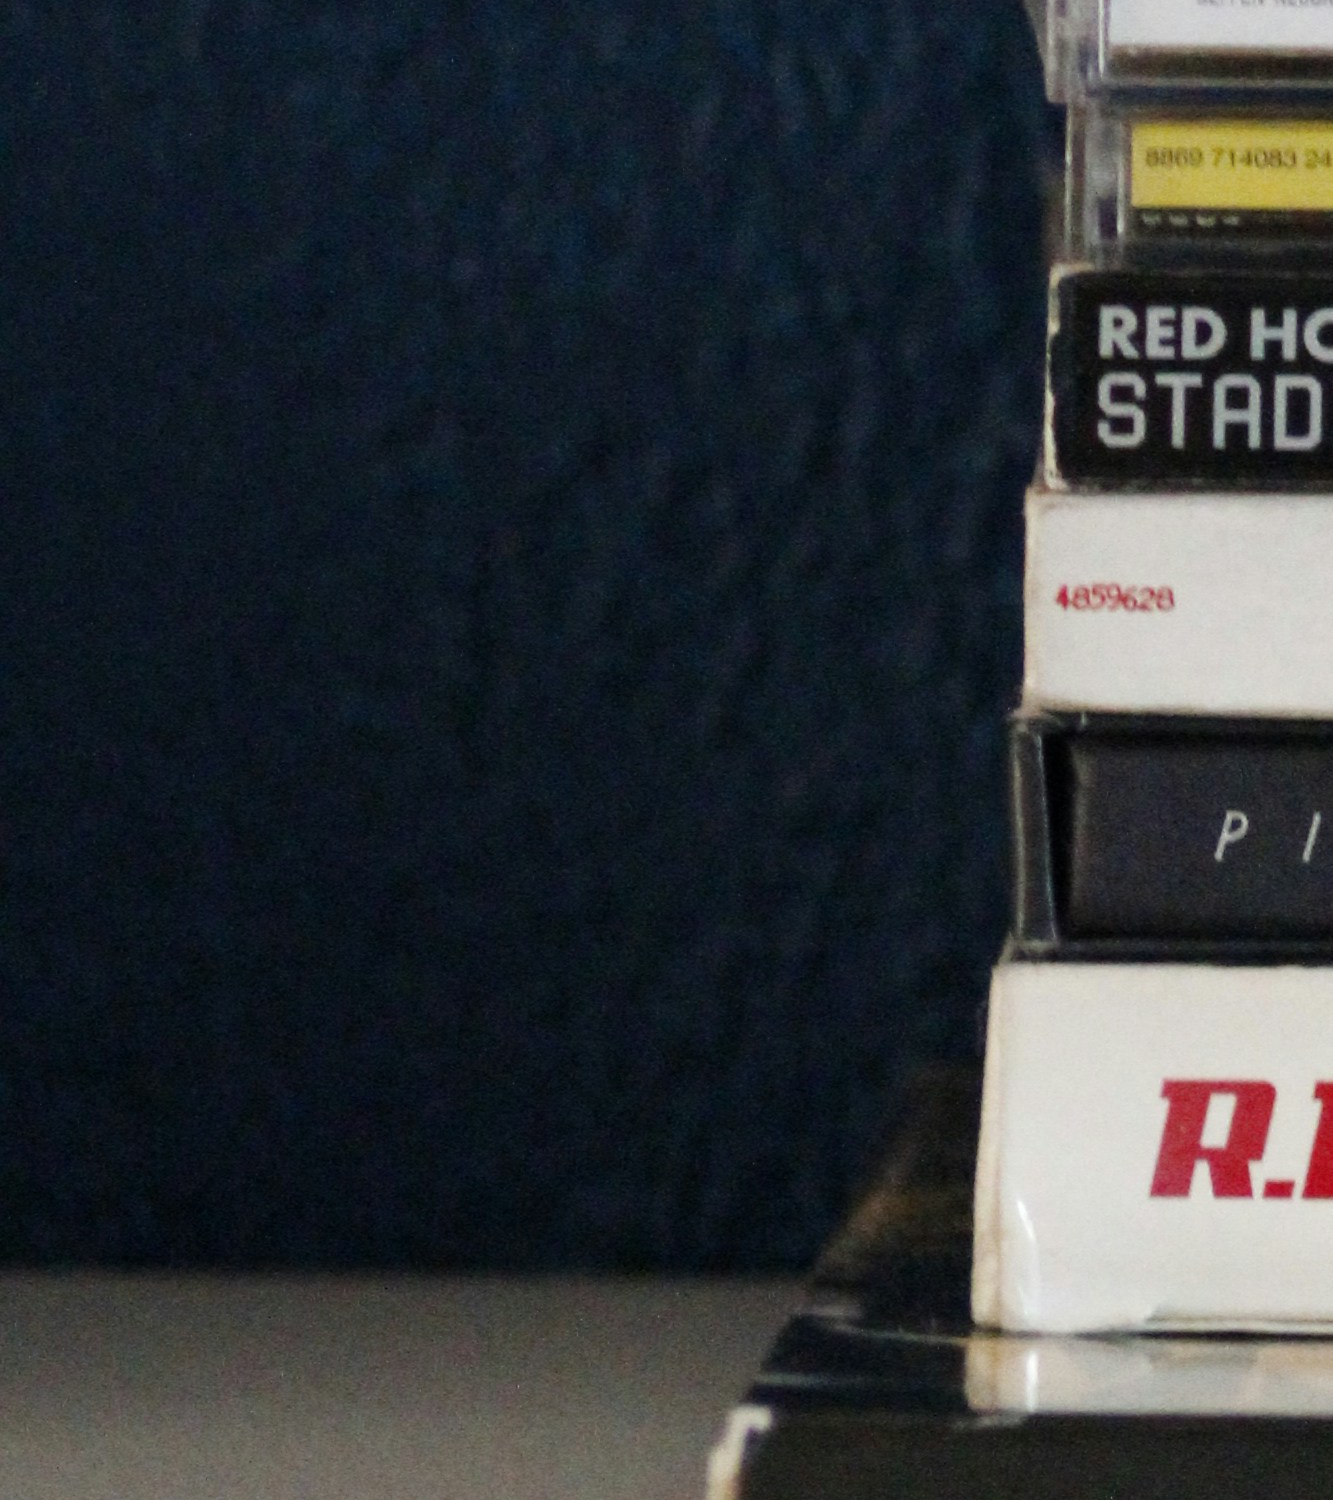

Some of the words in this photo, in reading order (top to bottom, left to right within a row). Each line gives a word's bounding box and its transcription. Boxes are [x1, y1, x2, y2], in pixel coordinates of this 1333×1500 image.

[1145, 148, 1202, 170] 8869
[1211, 149, 1296, 170] 714083
[1305, 151, 1332, 170] 24
[1097, 306, 1226, 361] RED
